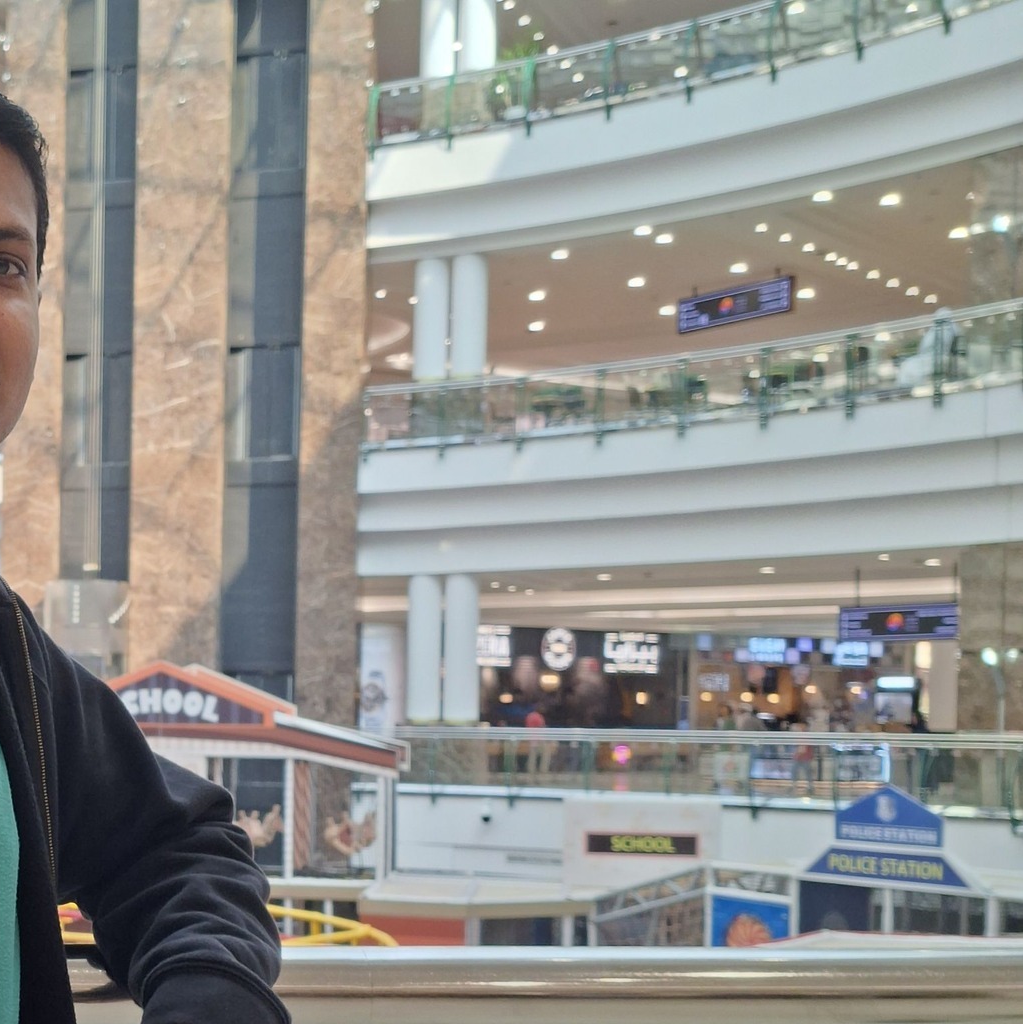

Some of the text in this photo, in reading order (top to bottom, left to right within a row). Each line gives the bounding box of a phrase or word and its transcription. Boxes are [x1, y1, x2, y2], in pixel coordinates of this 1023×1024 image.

[120, 687, 219, 723] CHOOL
[610, 835, 676, 854] SCHOOL
[829, 853, 944, 881] POLICE STATION
